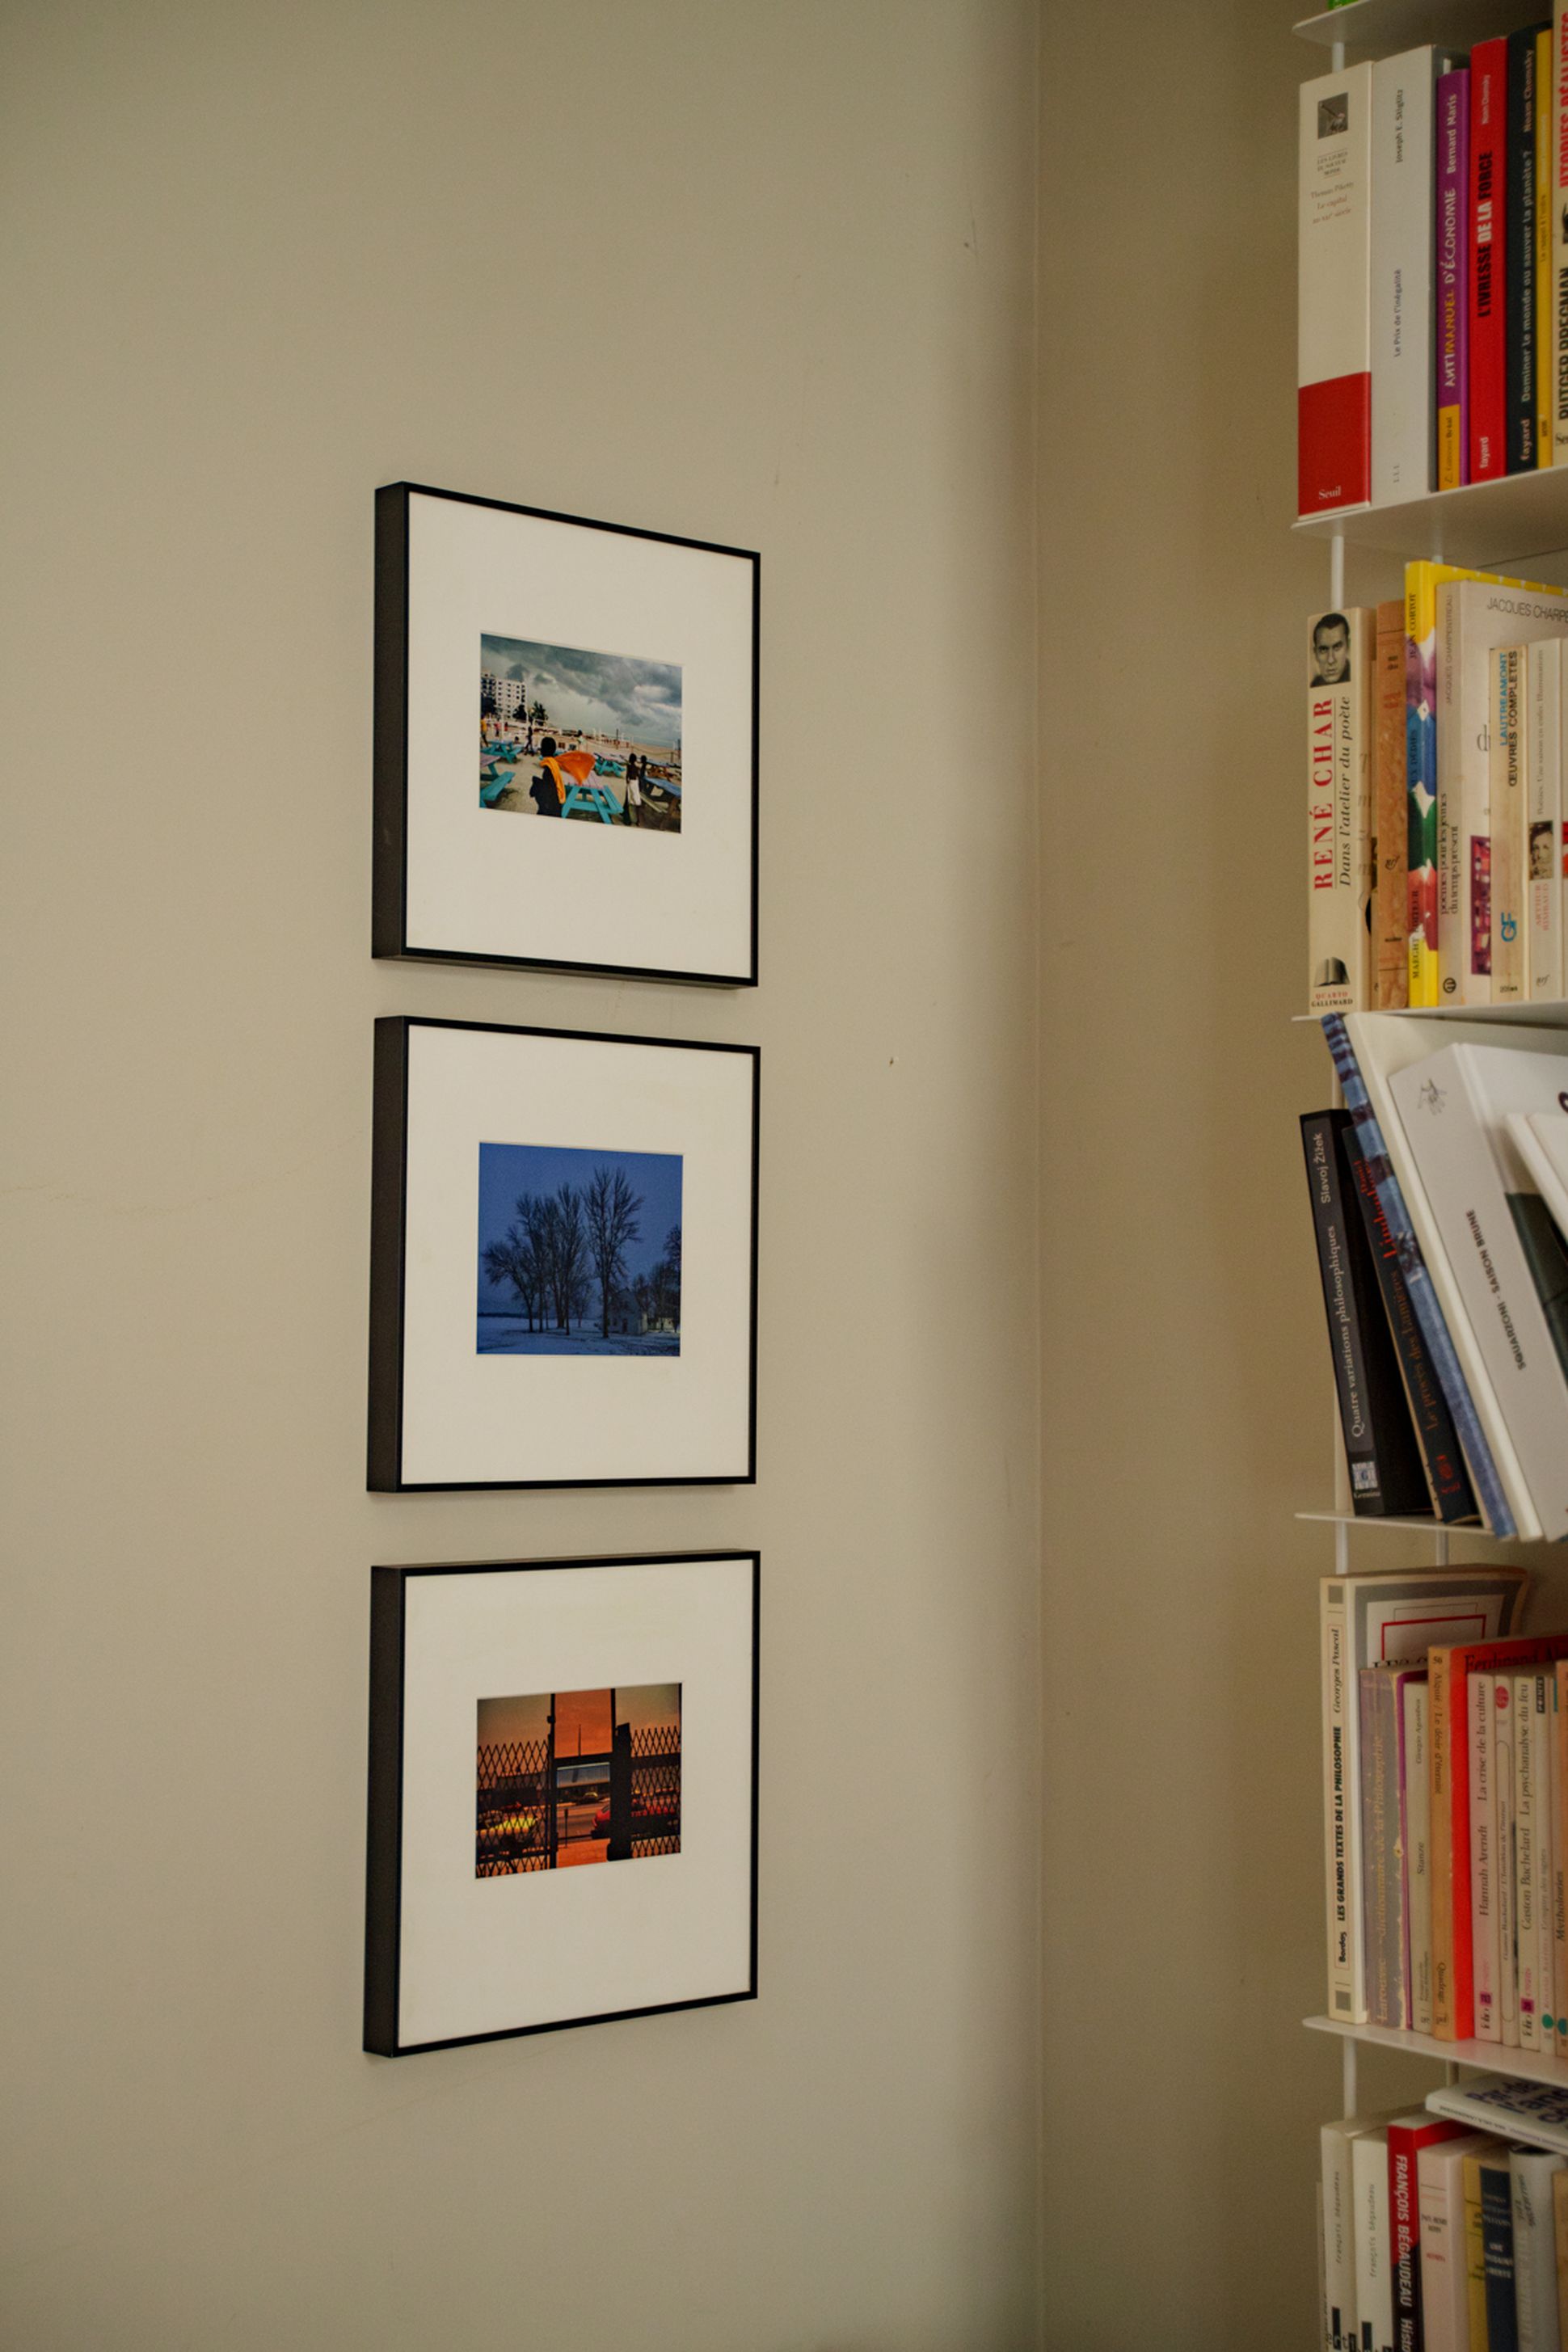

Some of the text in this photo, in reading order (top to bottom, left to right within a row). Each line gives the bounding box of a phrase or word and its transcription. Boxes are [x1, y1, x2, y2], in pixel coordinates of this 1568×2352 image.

[1396, 89, 1404, 120] Stiglitz
[1524, 48, 1533, 133] Noam Chomsky
[1396, 132, 1404, 164] Joseph
[1448, 93, 1457, 174] Bernard Maris
[1477, 151, 1493, 318] L'IVRESSE DE LA FORCE
[1523, 209, 1532, 223] la
[1524, 226, 1532, 268] sauver
[1393, 269, 1403, 312] l'inégalité
[1523, 271, 1532, 286] ou
[1393, 314, 1402, 326] de
[1523, 289, 1532, 331] monde
[1394, 347, 1401, 357] Le
[1444, 289, 1456, 387] ANTIMANUEL
[1521, 334, 1532, 345] le
[1522, 349, 1532, 403] Dominer
[1480, 436, 1490, 469] fayard
[1520, 417, 1532, 461] fayard
[1318, 485, 1342, 499] Seuil
[1409, 592, 1417, 660] JEAN CORTOT
[1486, 596, 1531, 617] JACQUES
[1499, 652, 1508, 746] LAUTREAMONT
[1508, 651, 1518, 727] COMPLETES
[1310, 698, 1333, 891] RENÉ CHAR
[1340, 696, 1352, 887] Dans l'atelier du poète
[1439, 828, 1447, 844] les
[1440, 845, 1448, 870] pour
[1451, 865, 1461, 898] temps
[1451, 899, 1458, 915] du
[1500, 912, 1517, 943] GF
[1311, 997, 1354, 1008] GALLIMARD
[1315, 991, 1349, 1000] QUARTO
[1313, 1132, 1331, 1204] Slavoj Žižek
[1465, 1209, 1486, 1248] BRUNE
[1479, 1248, 1501, 1294] SAISON
[1328, 1225, 1364, 1439] Quatre variations philosophiques
[1496, 1300, 1527, 1371] SQUARZONI
[1333, 1668, 1341, 1713] Georges
[1477, 1682, 1486, 1723] culture
[1476, 1725, 1486, 1735] la
[1477, 1738, 1486, 1754] de
[1519, 1684, 1532, 1817] La psychanalyse du feu
[1477, 1786, 1488, 1802] La
[1333, 1726, 1345, 1922] LES GRANDS TEXTES DE LA PHILOSOPHIE
[1479, 1825, 1489, 1916] Hannah Arendt
[1520, 1827, 1532, 1930] Gaston Bachelard
[1338, 1932, 1347, 1963] Bordas
[1334, 2171, 1342, 2218] bégaudeau
[1396, 2154, 1410, 2221] FRANÇOIS
[1368, 2184, 1377, 2278] françois bégaudeau
[1398, 2223, 1414, 2308] BÉGAUDEAU
